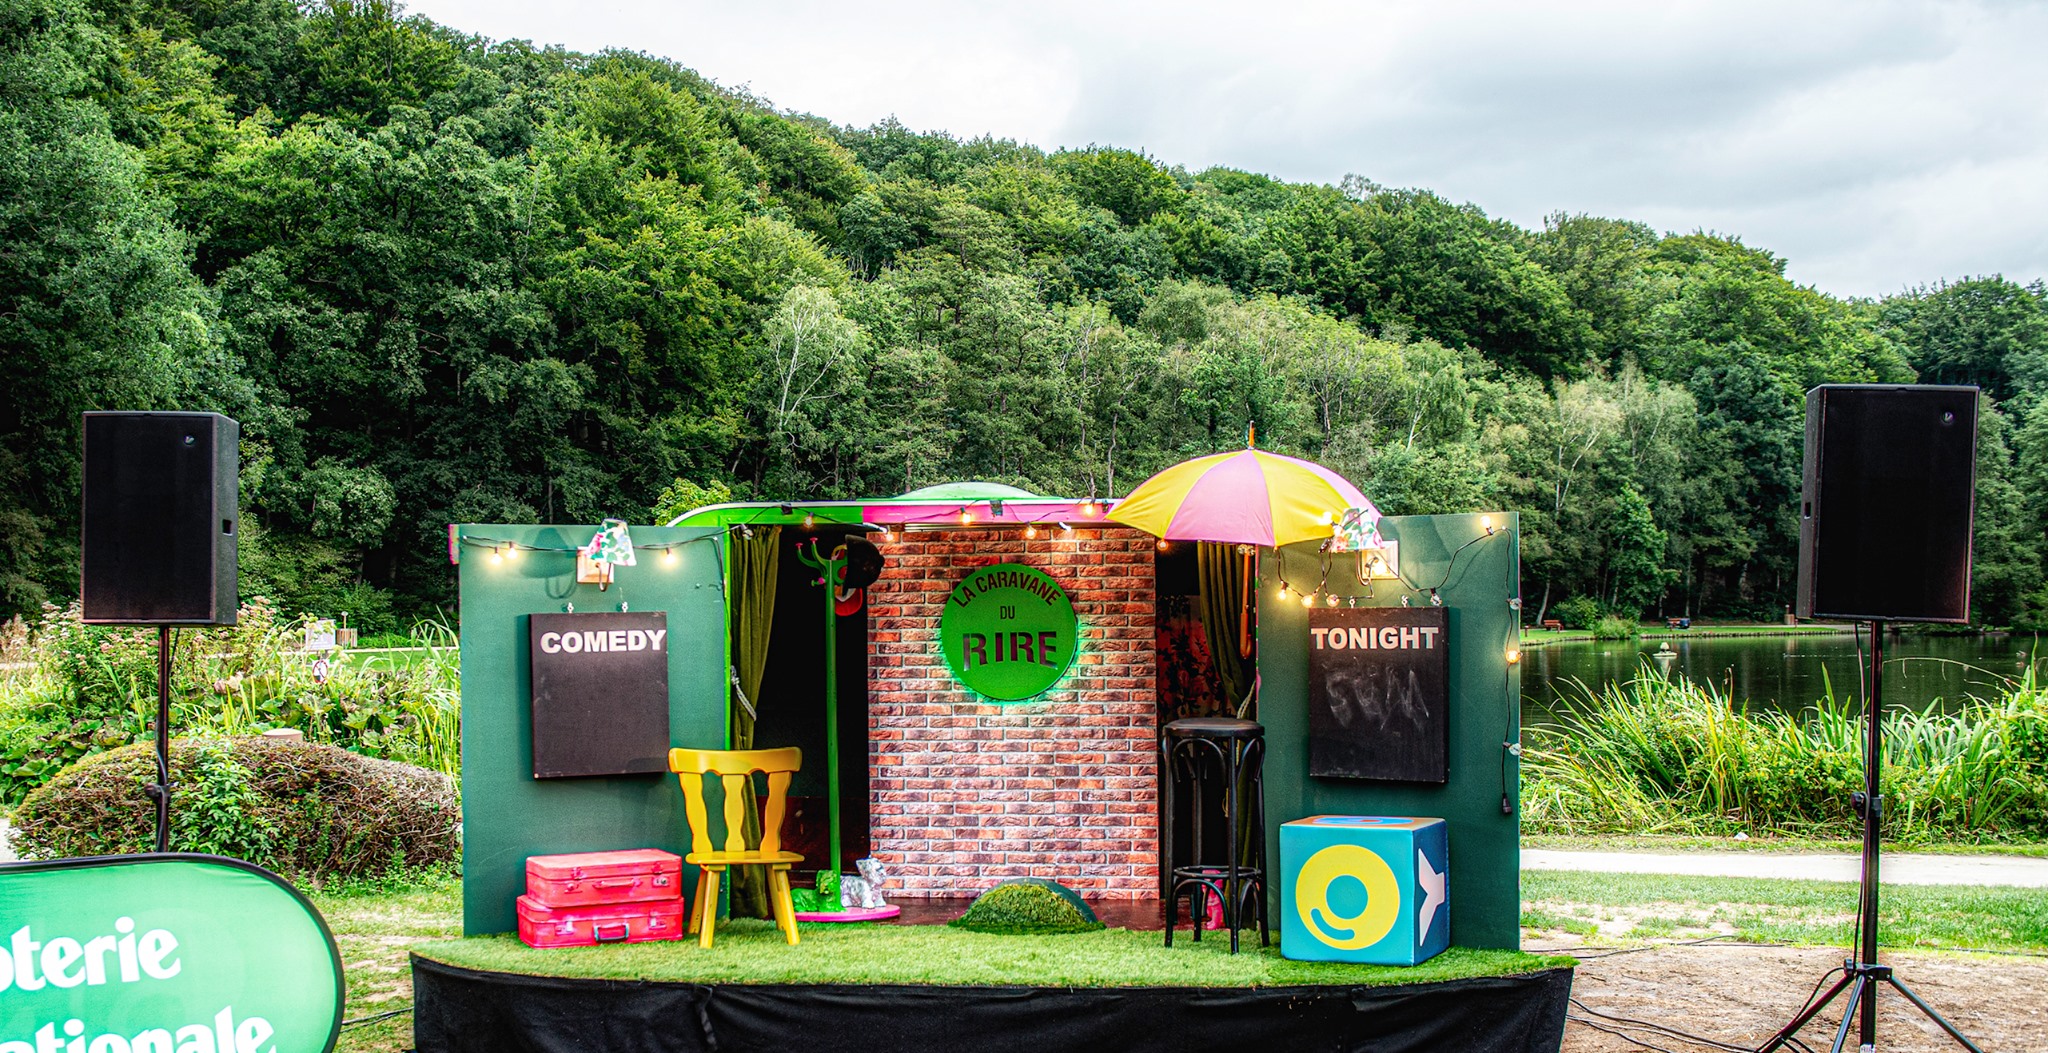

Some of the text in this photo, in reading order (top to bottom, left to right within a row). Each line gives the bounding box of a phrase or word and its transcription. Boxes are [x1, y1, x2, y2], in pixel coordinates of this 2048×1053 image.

[952, 571, 1062, 608] LA CARAVANE
[1000, 605, 1015, 620] DU
[540, 629, 667, 653] COMEDY
[962, 631, 1059, 671] RIRE
[1310, 626, 1439, 650] TONIGHT
[0, 1005, 277, 1053] tinale
